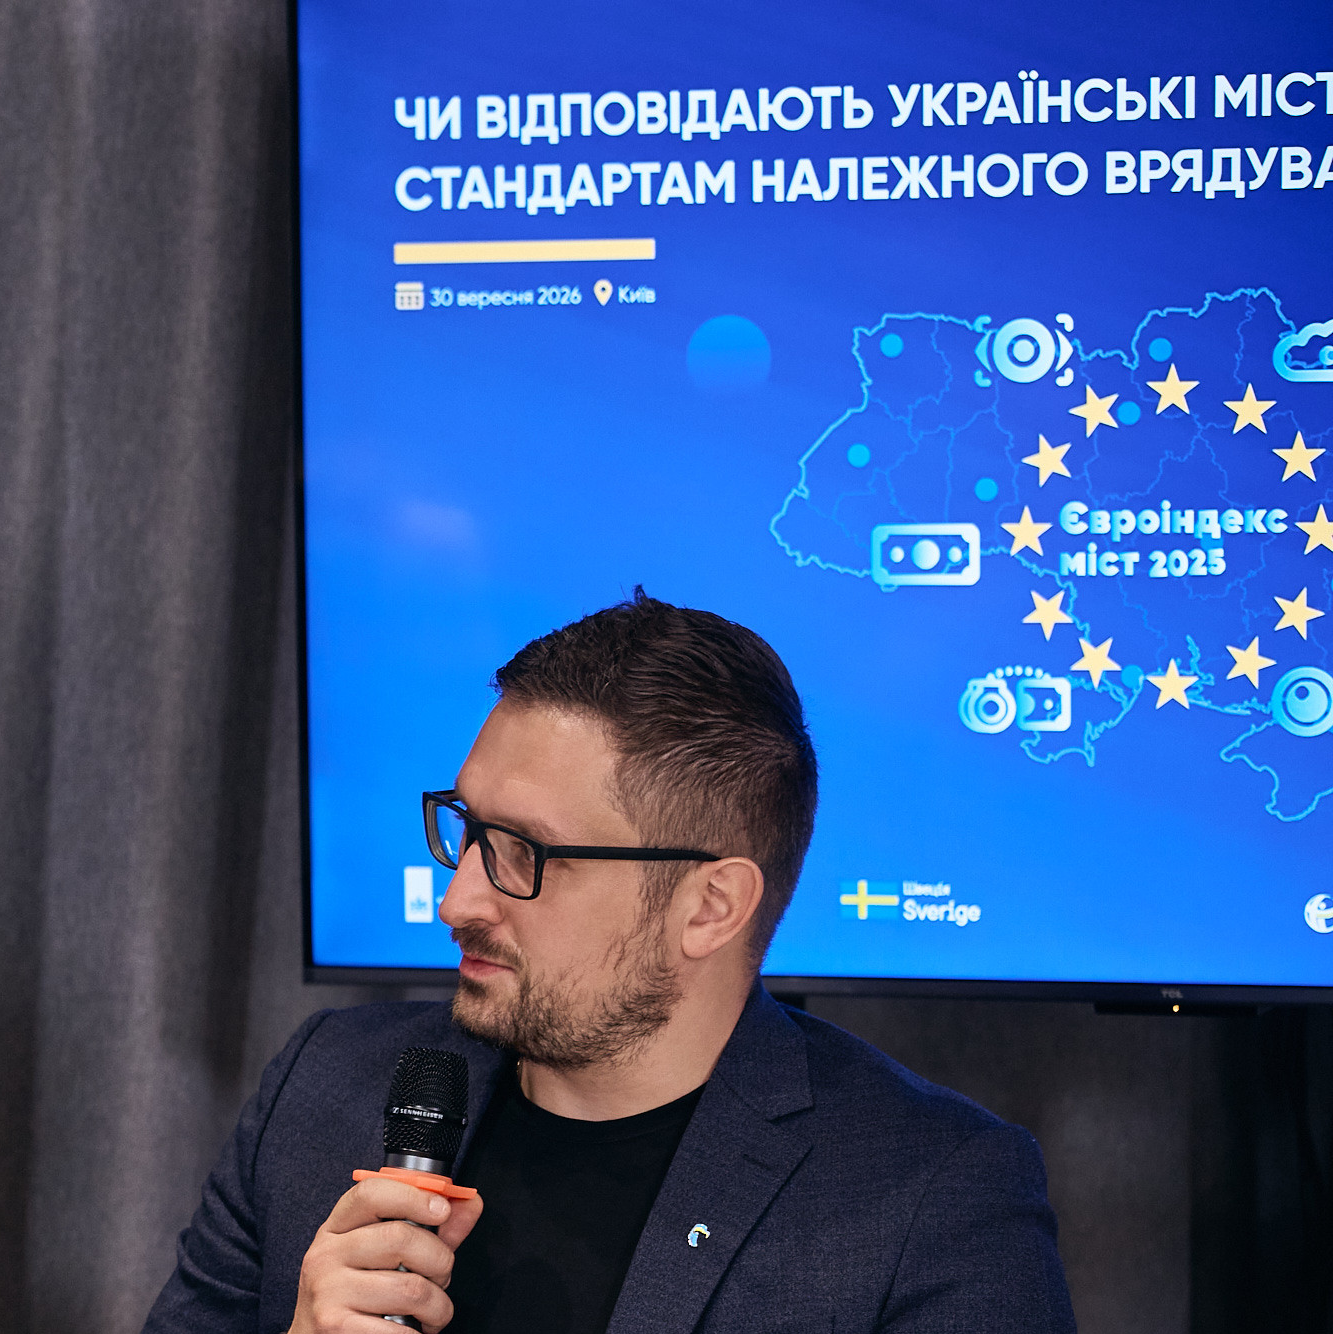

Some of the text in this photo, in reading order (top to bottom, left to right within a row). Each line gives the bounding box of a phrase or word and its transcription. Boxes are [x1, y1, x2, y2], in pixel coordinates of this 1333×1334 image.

[394, 95, 462, 141] ЧИ
[476, 86, 874, 146] ВІДПОВІДАЮТЬ
[887, 70, 1196, 128] УКРАЇНСЬКІ
[394, 160, 735, 216] СТАНДАРТАМ
[752, 151, 1089, 202] НАЛЕЖНОГО
[430, 285, 582, 310] 30 вересня 2026
[617, 284, 657, 304] Київ
[1059, 499, 1289, 542] Євроіндекс
[1059, 541, 1227, 578] міст 2025
[902, 898, 981, 927] Sverige
[400, 1108, 443, 1119] SENNHEISER
